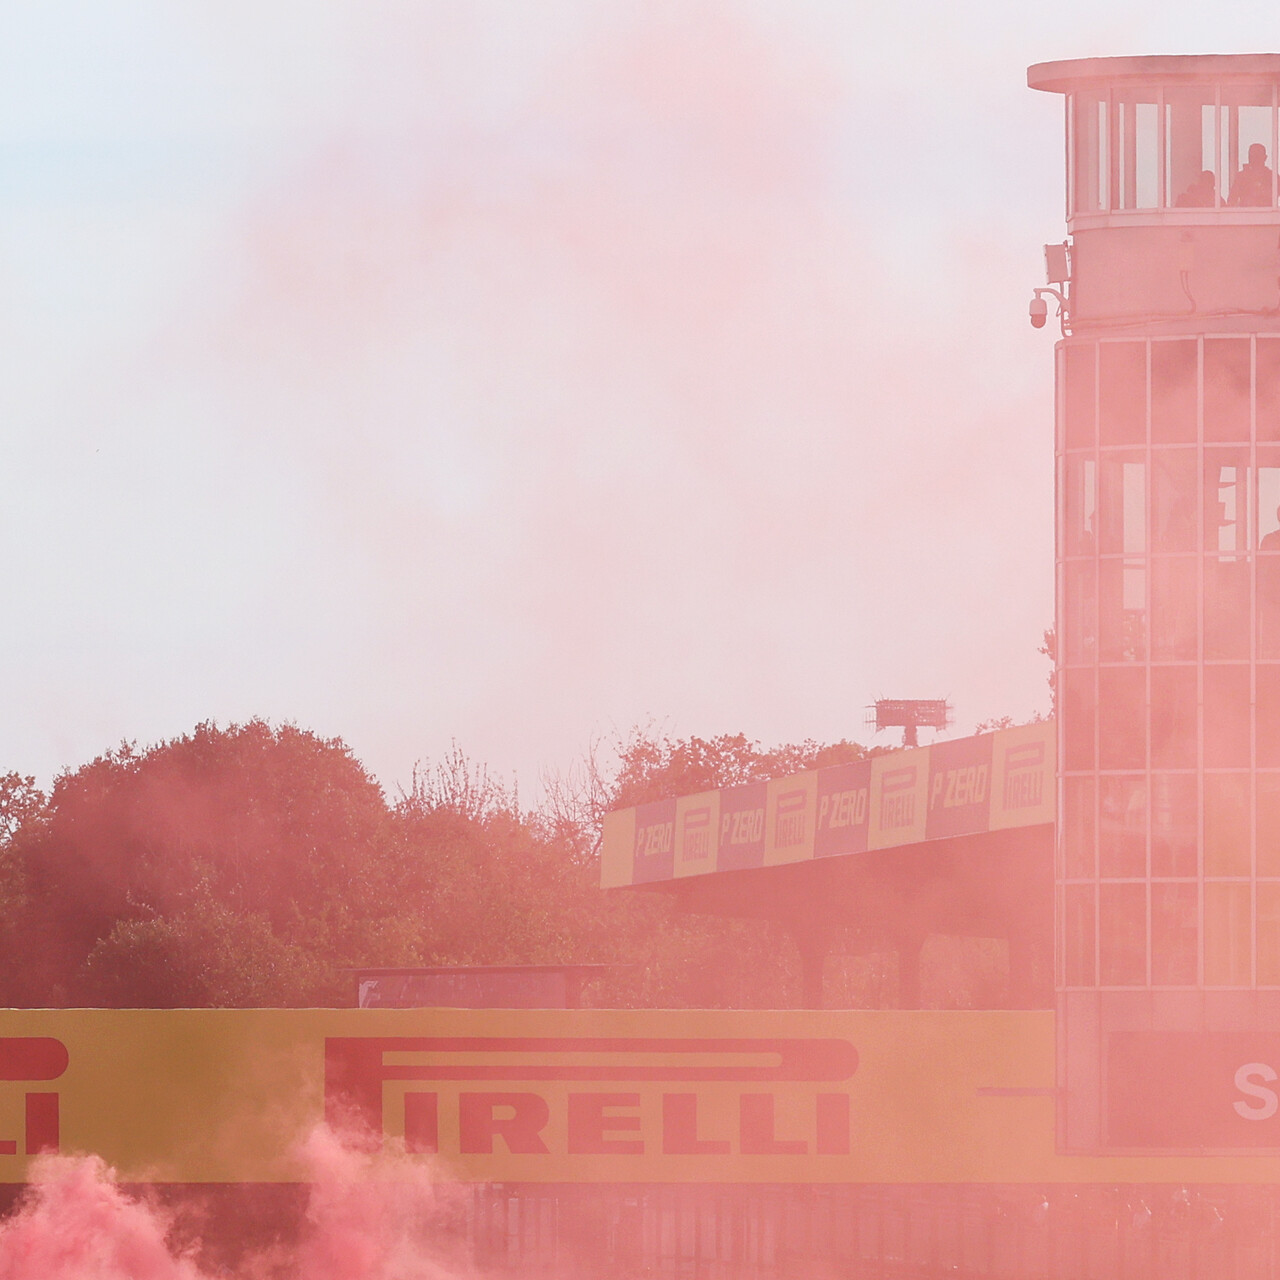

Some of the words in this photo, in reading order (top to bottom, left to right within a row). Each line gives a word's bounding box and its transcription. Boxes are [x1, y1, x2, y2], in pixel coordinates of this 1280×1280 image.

[943, 764, 989, 808] ZERO
[731, 808, 764, 844] ZERO
[829, 788, 867, 829] ZERO
[645, 822, 672, 856] ZERO
[324, 1037, 860, 1155] PIRELLI
